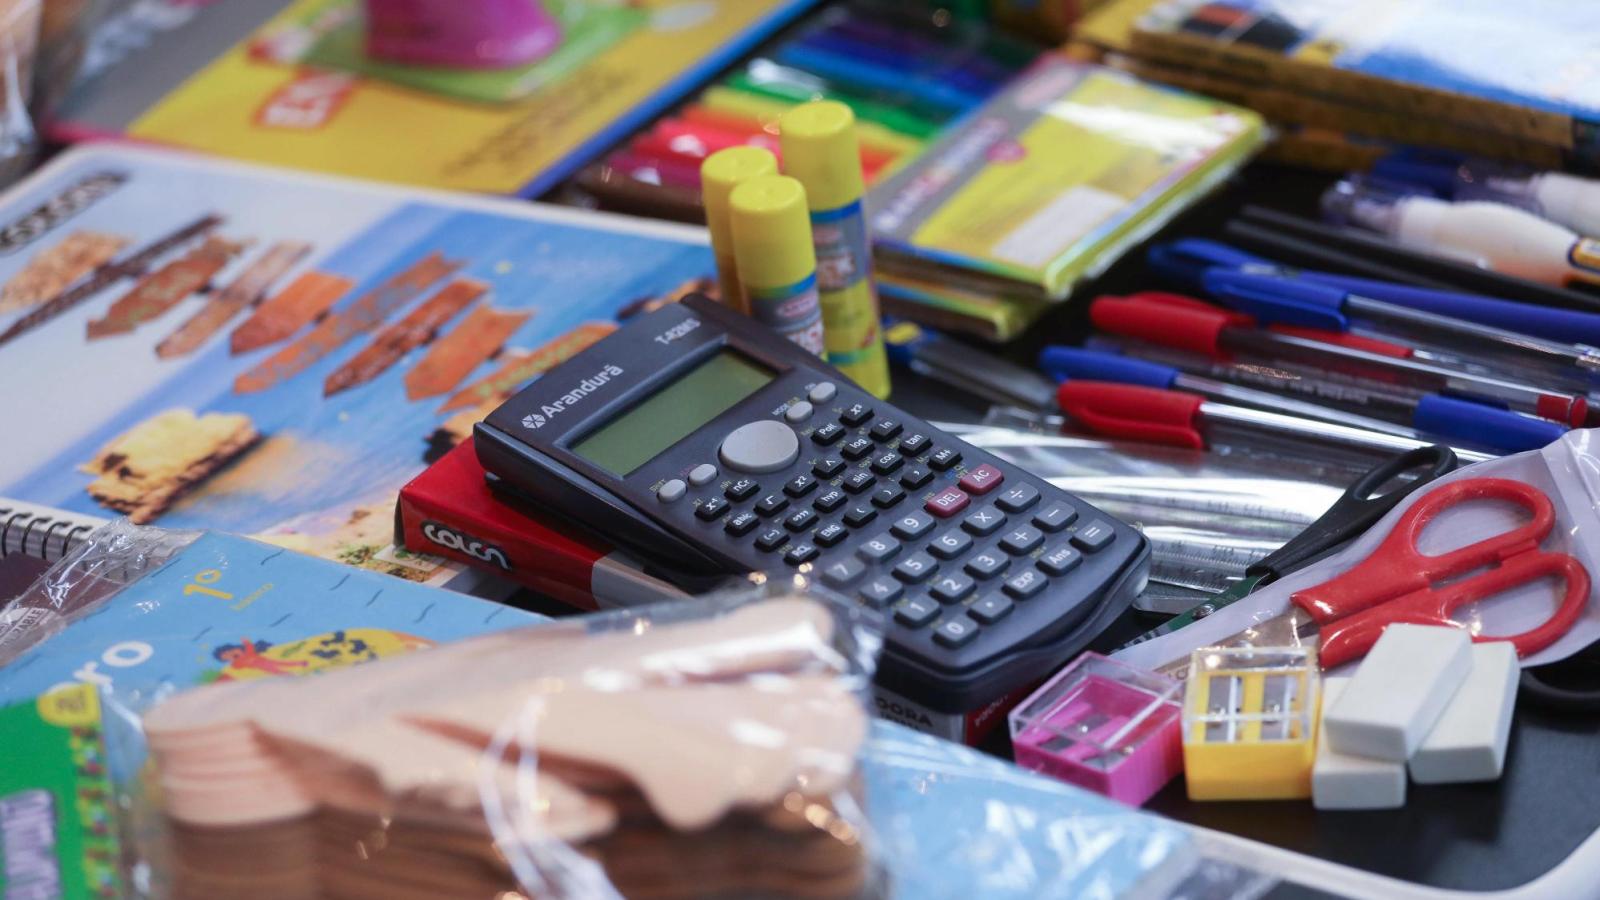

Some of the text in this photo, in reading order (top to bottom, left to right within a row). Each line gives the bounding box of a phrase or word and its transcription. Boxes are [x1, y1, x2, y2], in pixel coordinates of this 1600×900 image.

[849, 437, 867, 450] log
[905, 433, 922, 445] tan
[879, 452, 896, 464] cos
[852, 471, 868, 484] sin
[972, 469, 990, 482] AC
[733, 478, 750, 492] nCr
[936, 492, 961, 506] DEL
[903, 516, 920, 529] 9
[820, 524, 841, 538] ENG
[869, 540, 886, 551] 8
[942, 535, 959, 546] 6
[977, 554, 995, 567] 3
[1048, 547, 1072, 565] Ans
[833, 563, 849, 576] 7
[905, 559, 922, 570] 5
[942, 578, 962, 591] 2
[1013, 570, 1035, 589] EXP
[873, 582, 888, 592] 4
[910, 601, 925, 612] 1
[946, 622, 964, 634] 0
